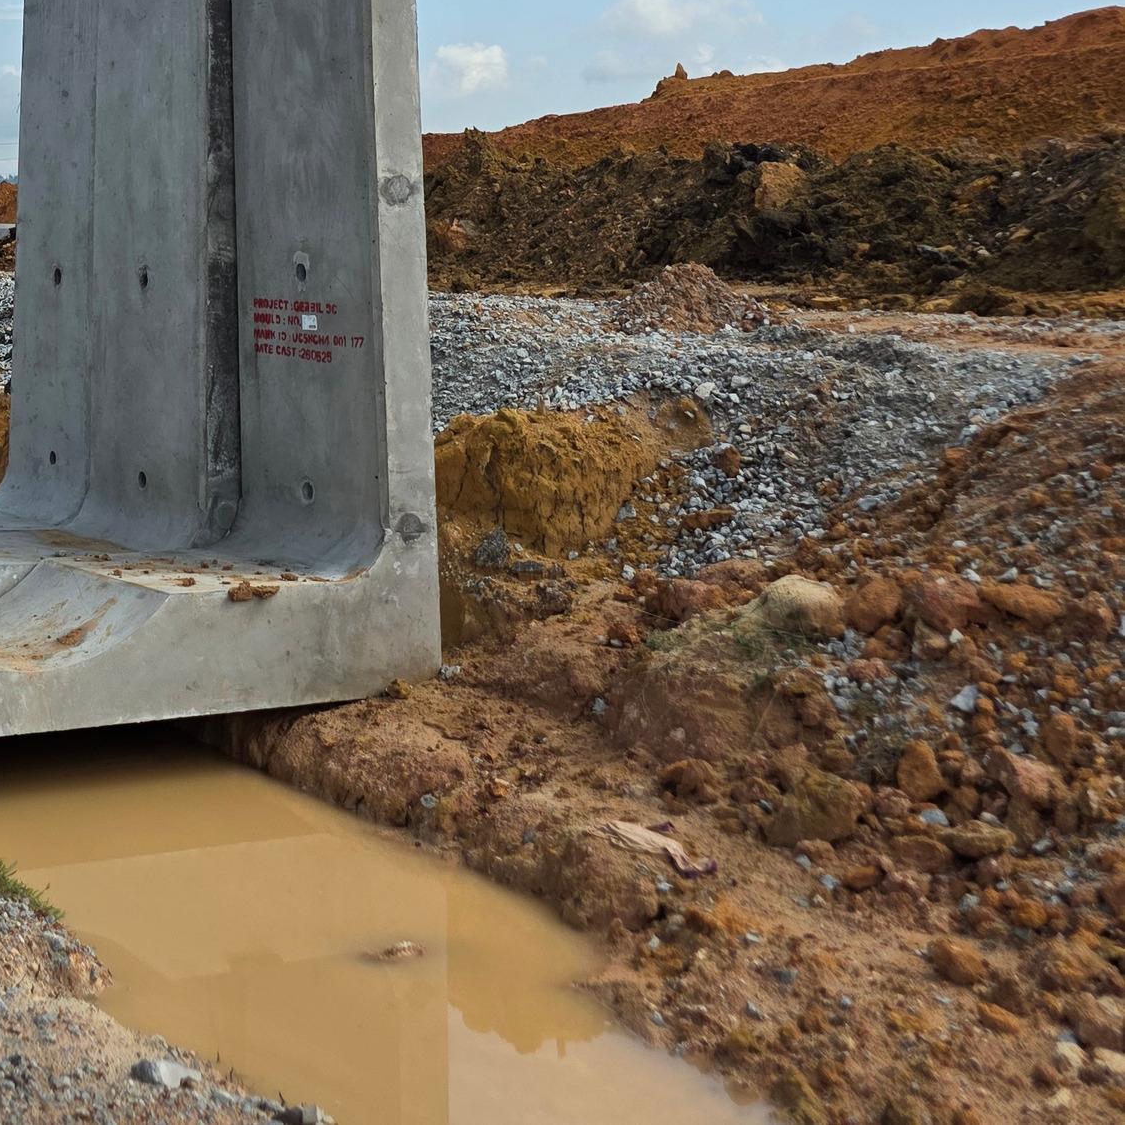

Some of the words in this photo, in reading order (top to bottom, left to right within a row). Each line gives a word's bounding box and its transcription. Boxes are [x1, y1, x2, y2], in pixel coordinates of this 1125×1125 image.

[253, 298, 289, 310] PROJECT
[351, 336, 364, 348] 177
[254, 343, 274, 354] DATE
[276, 345, 296, 357] CAST
